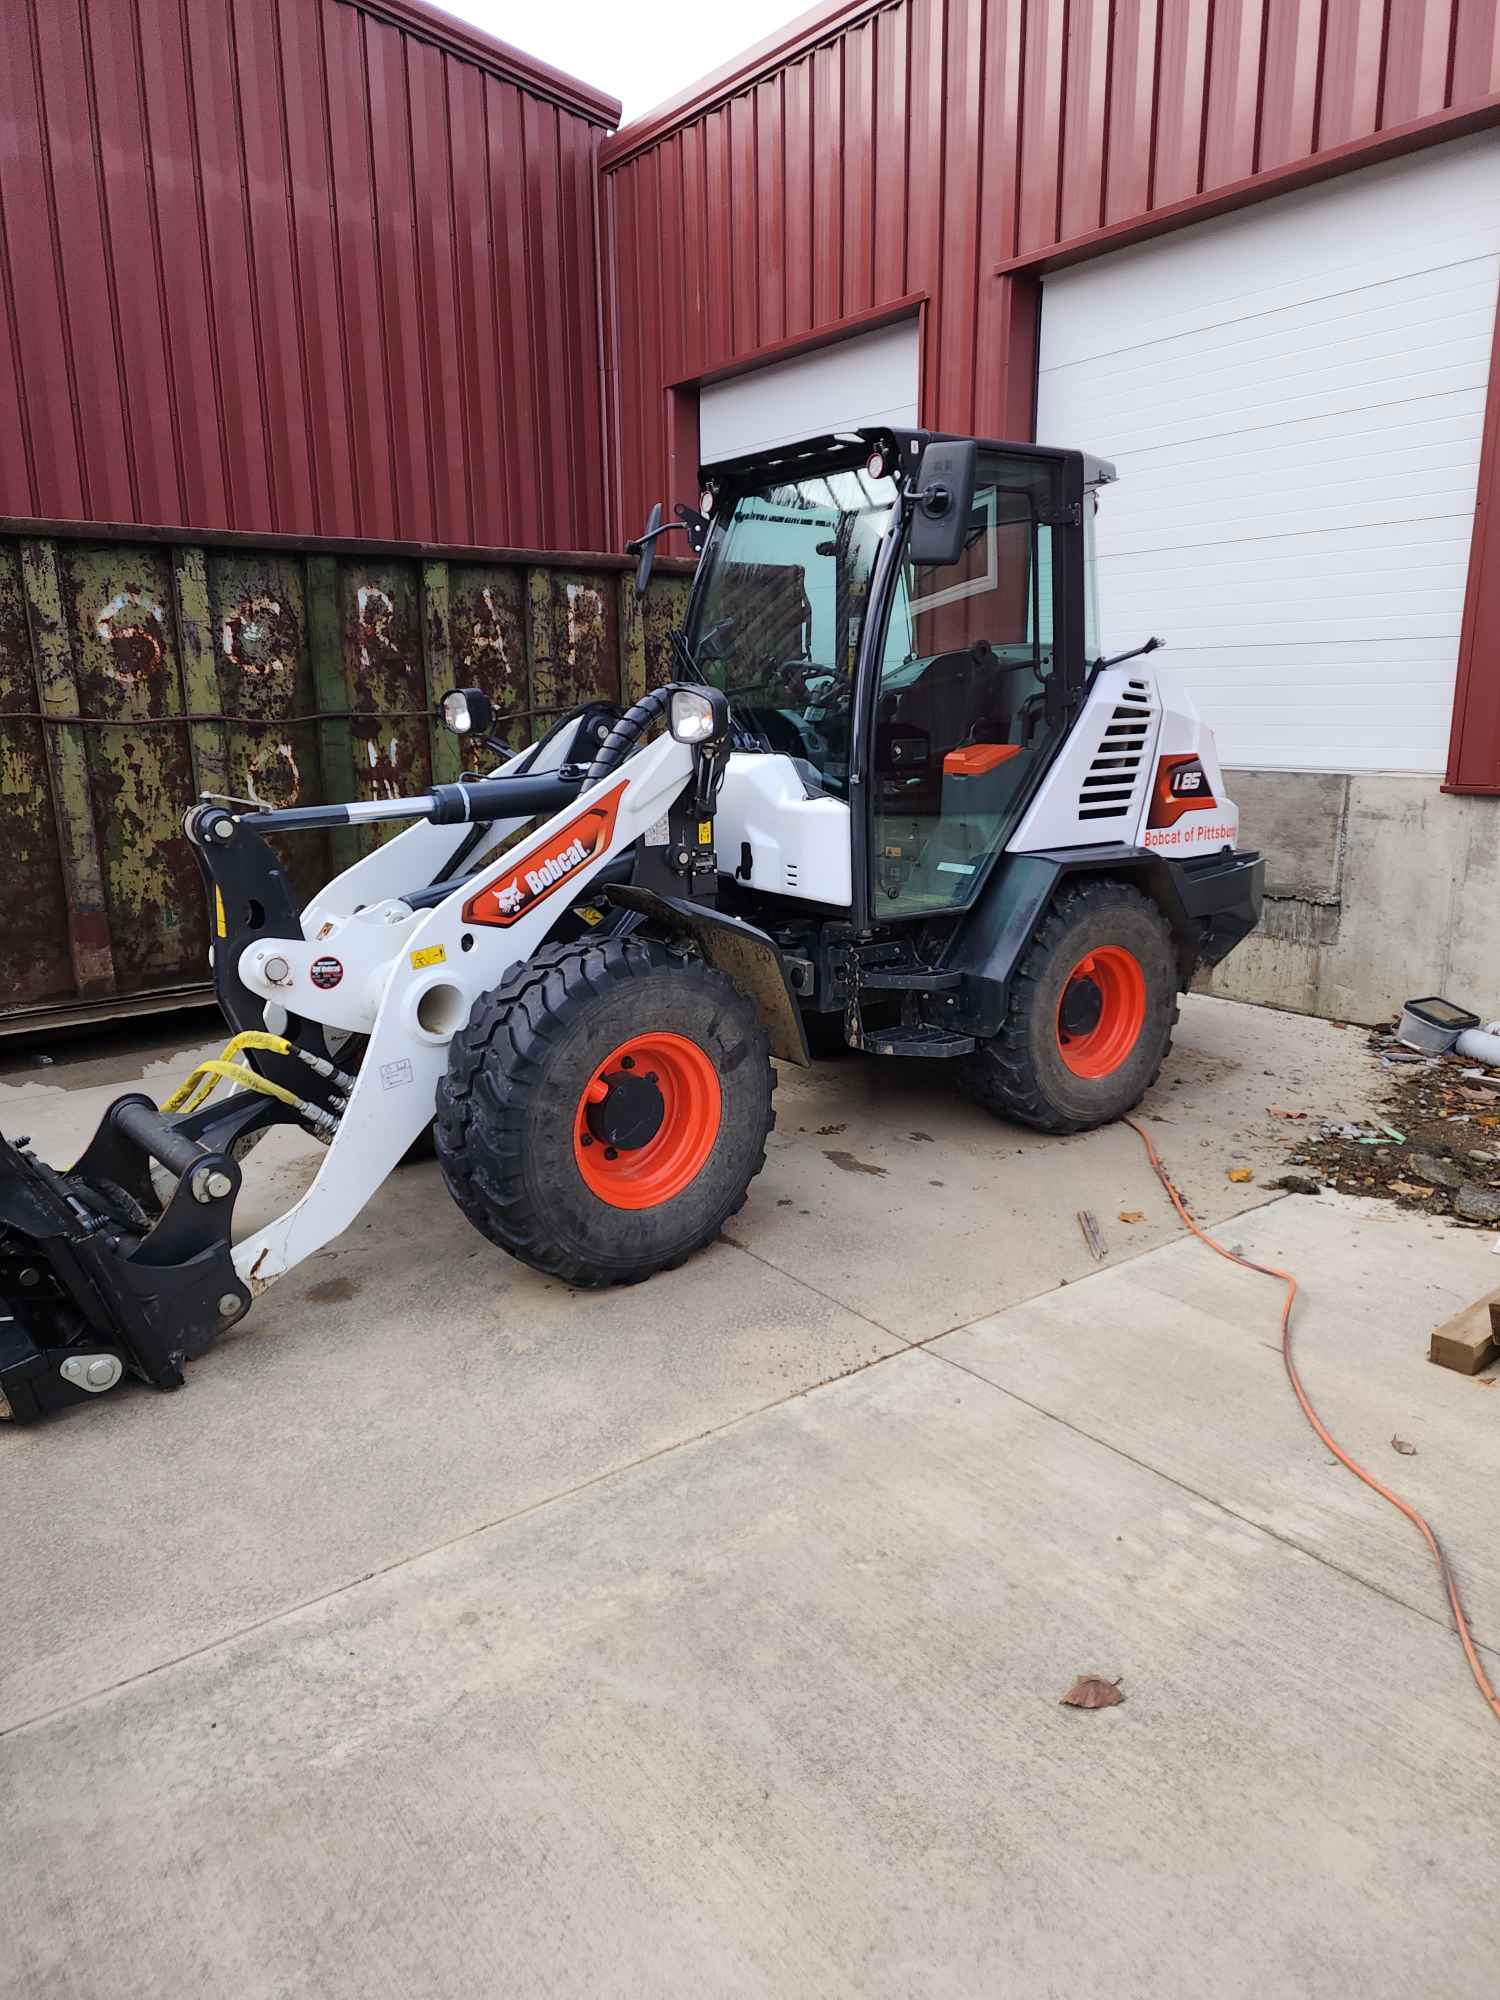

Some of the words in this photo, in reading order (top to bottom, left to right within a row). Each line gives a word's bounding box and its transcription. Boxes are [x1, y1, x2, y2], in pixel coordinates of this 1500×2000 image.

[97, 584, 603, 683] SCRAP
[525, 837, 586, 896] Bobcat
[1144, 829, 1180, 847] Bobcat
[1183, 827, 1194, 842] of
